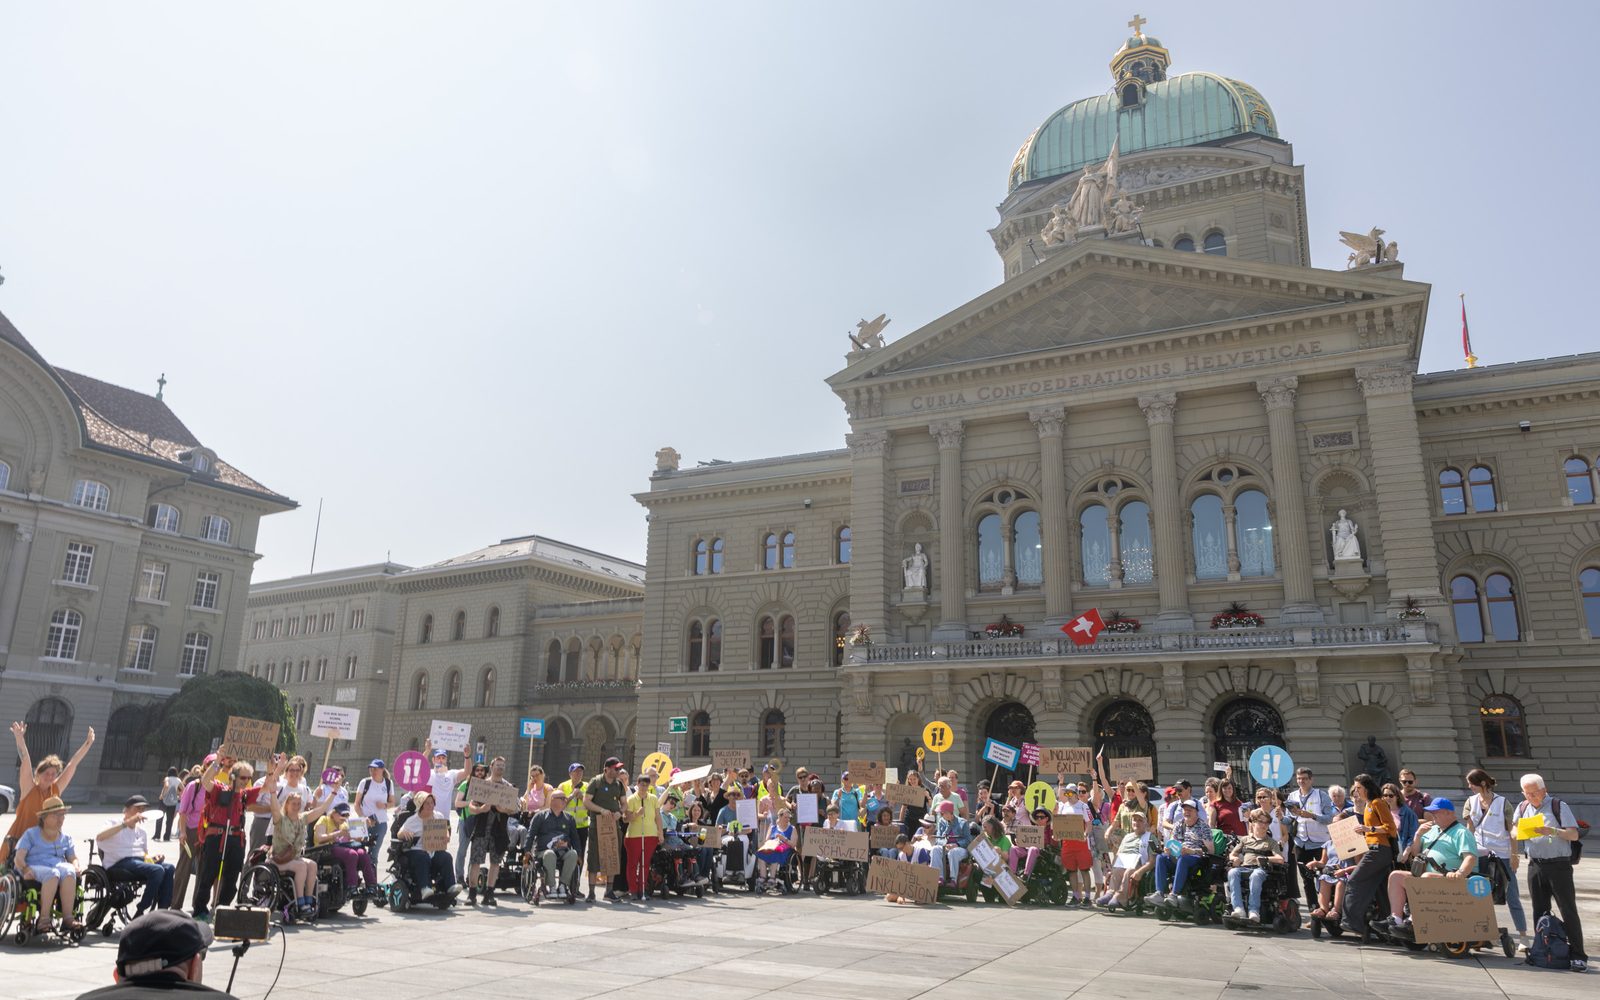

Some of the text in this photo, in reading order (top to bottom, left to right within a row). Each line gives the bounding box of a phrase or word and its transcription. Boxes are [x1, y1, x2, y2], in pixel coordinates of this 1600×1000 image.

[911, 340, 1323, 411] CURIA CONFOEDERATIONIS HELVETICAE
[1049, 749, 1086, 762] INCLUSION
[1261, 754, 1281, 780] i!
[403, 758, 422, 784] i!
[817, 845, 867, 860] SCHWEIZ
[870, 875, 936, 903] INKLUSION
[904, 872, 921, 886] TEIL
